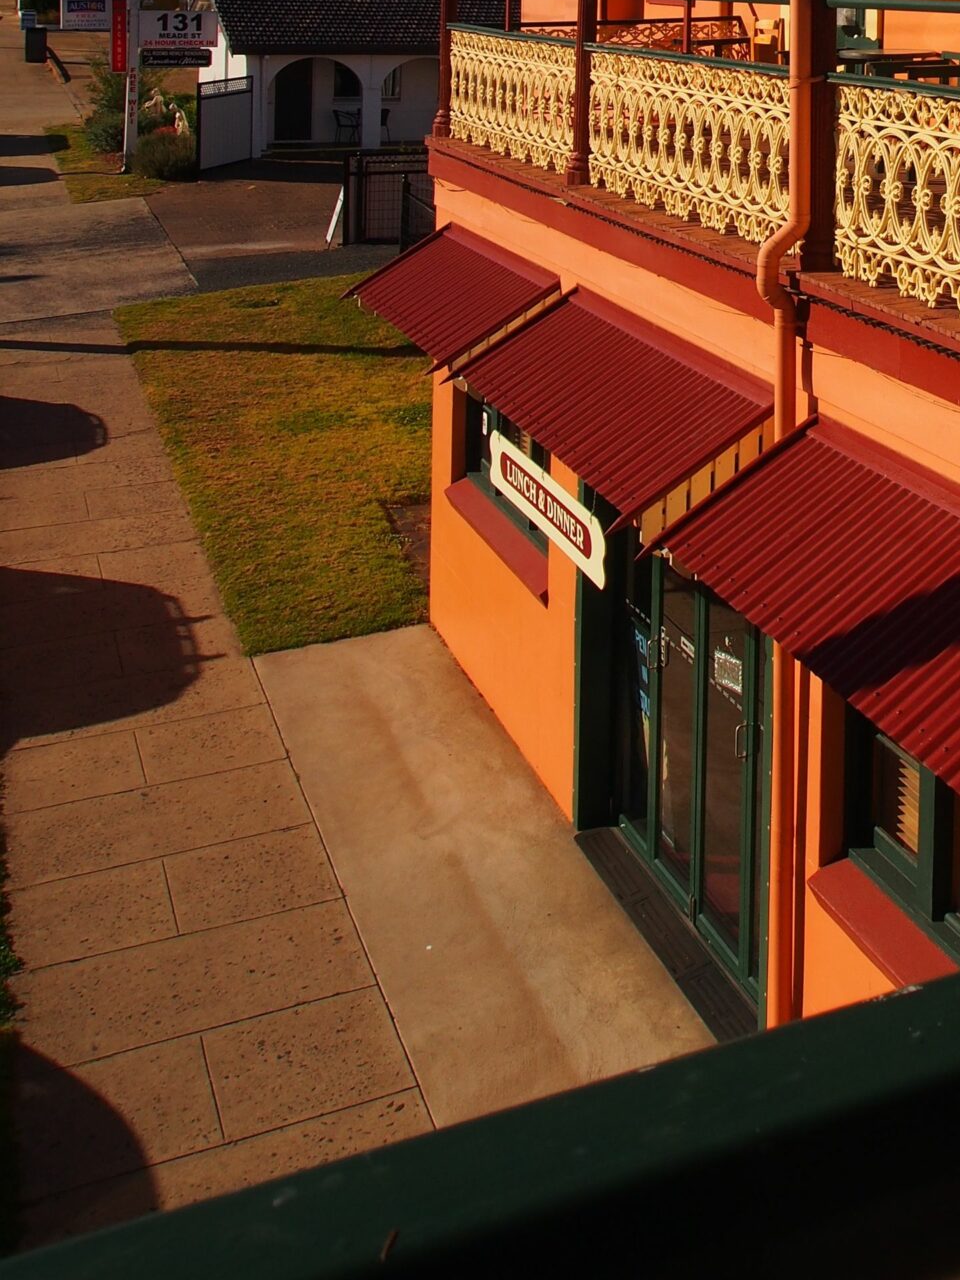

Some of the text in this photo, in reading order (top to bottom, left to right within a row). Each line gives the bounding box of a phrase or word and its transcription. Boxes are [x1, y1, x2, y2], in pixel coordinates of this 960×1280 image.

[157, 13, 201, 32] 131
[129, 100, 137, 124] WIFI
[507, 460, 584, 550] LUNCH & DINNER
